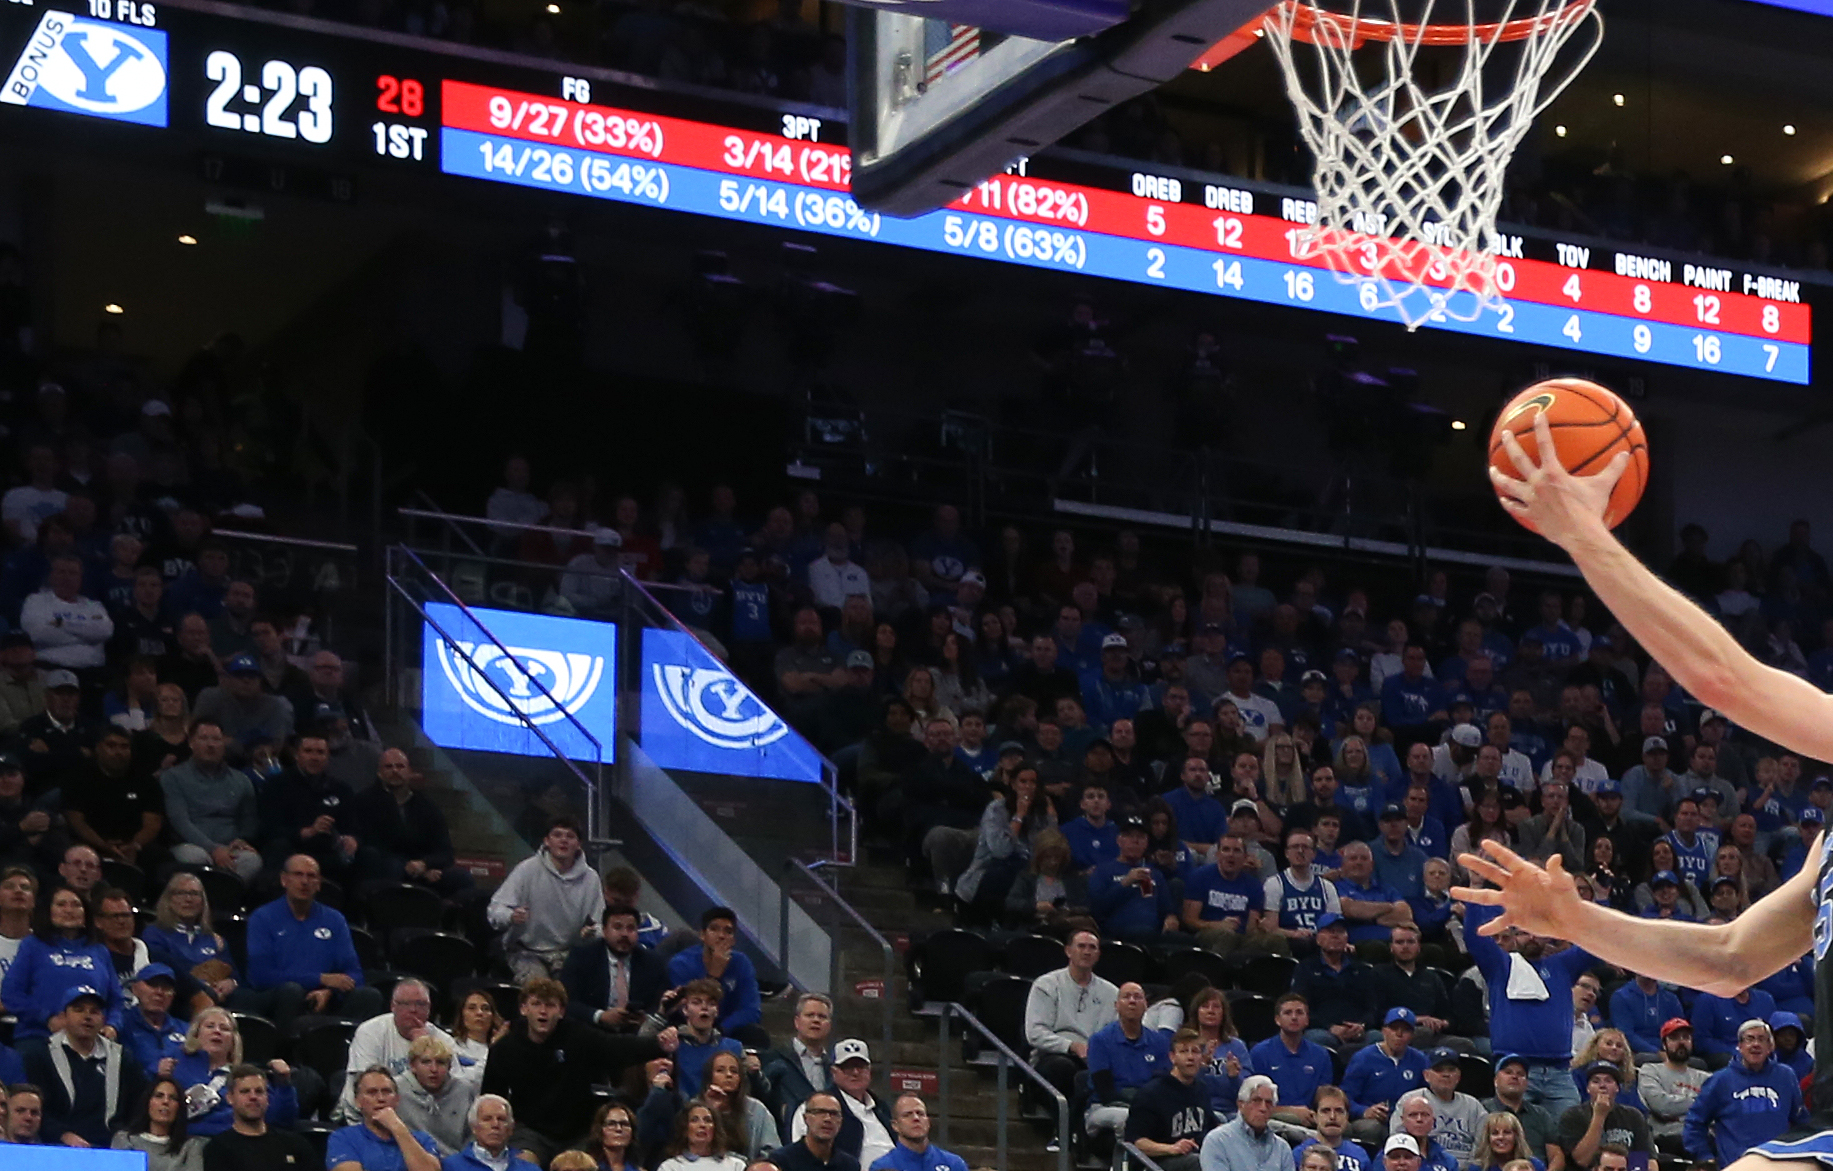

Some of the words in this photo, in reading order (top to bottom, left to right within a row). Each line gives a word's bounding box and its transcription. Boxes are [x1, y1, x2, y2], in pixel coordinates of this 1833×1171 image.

[117, 0, 156, 26] FLS
[11, 18, 64, 99] BONUS
[205, 50, 333, 144] 2:23
[376, 74, 424, 117] 28
[372, 122, 427, 160] 1ST
[489, 96, 569, 138] 9/27
[574, 109, 664, 158] (33%)
[723, 136, 795, 176] 3/14
[480, 141, 574, 185] 14/26
[581, 156, 669, 204] (54%)
[562, 76, 591, 105] FG
[781, 115, 821, 143] 3PT
[1282, 198, 1317, 225] REB
[1556, 242, 1590, 269] TOV
[1615, 253, 1671, 283] BENCH
[1683, 264, 1733, 292] PAINT
[1743, 274, 1800, 304] F-BREAK
[719, 180, 790, 219] 5/14
[1007, 182, 1089, 227] (82%)
[1146, 205, 1166, 235] 5
[1213, 216, 1243, 249] 12
[944, 216, 999, 253] 5/8
[1004, 225, 1087, 270] (63%)
[1360, 242, 1377, 270] 3
[1146, 248, 1165, 278] 2
[1213, 259, 1243, 291] 14
[1284, 270, 1314, 301] 16
[1360, 283, 1378, 311] 6
[1563, 274, 1581, 302] 4
[1634, 285, 1652, 313] 8
[1498, 304, 1514, 334] 2
[1693, 296, 1720, 324] 12
[1762, 305, 1780, 333] 8
[1563, 315, 1581, 343] 4
[1633, 325, 1652, 354] 9
[1693, 335, 1722, 364] 16
[1763, 345, 1780, 373] 7
[495, 657, 546, 697] Y
[1287, 897, 1322, 912] BYU
